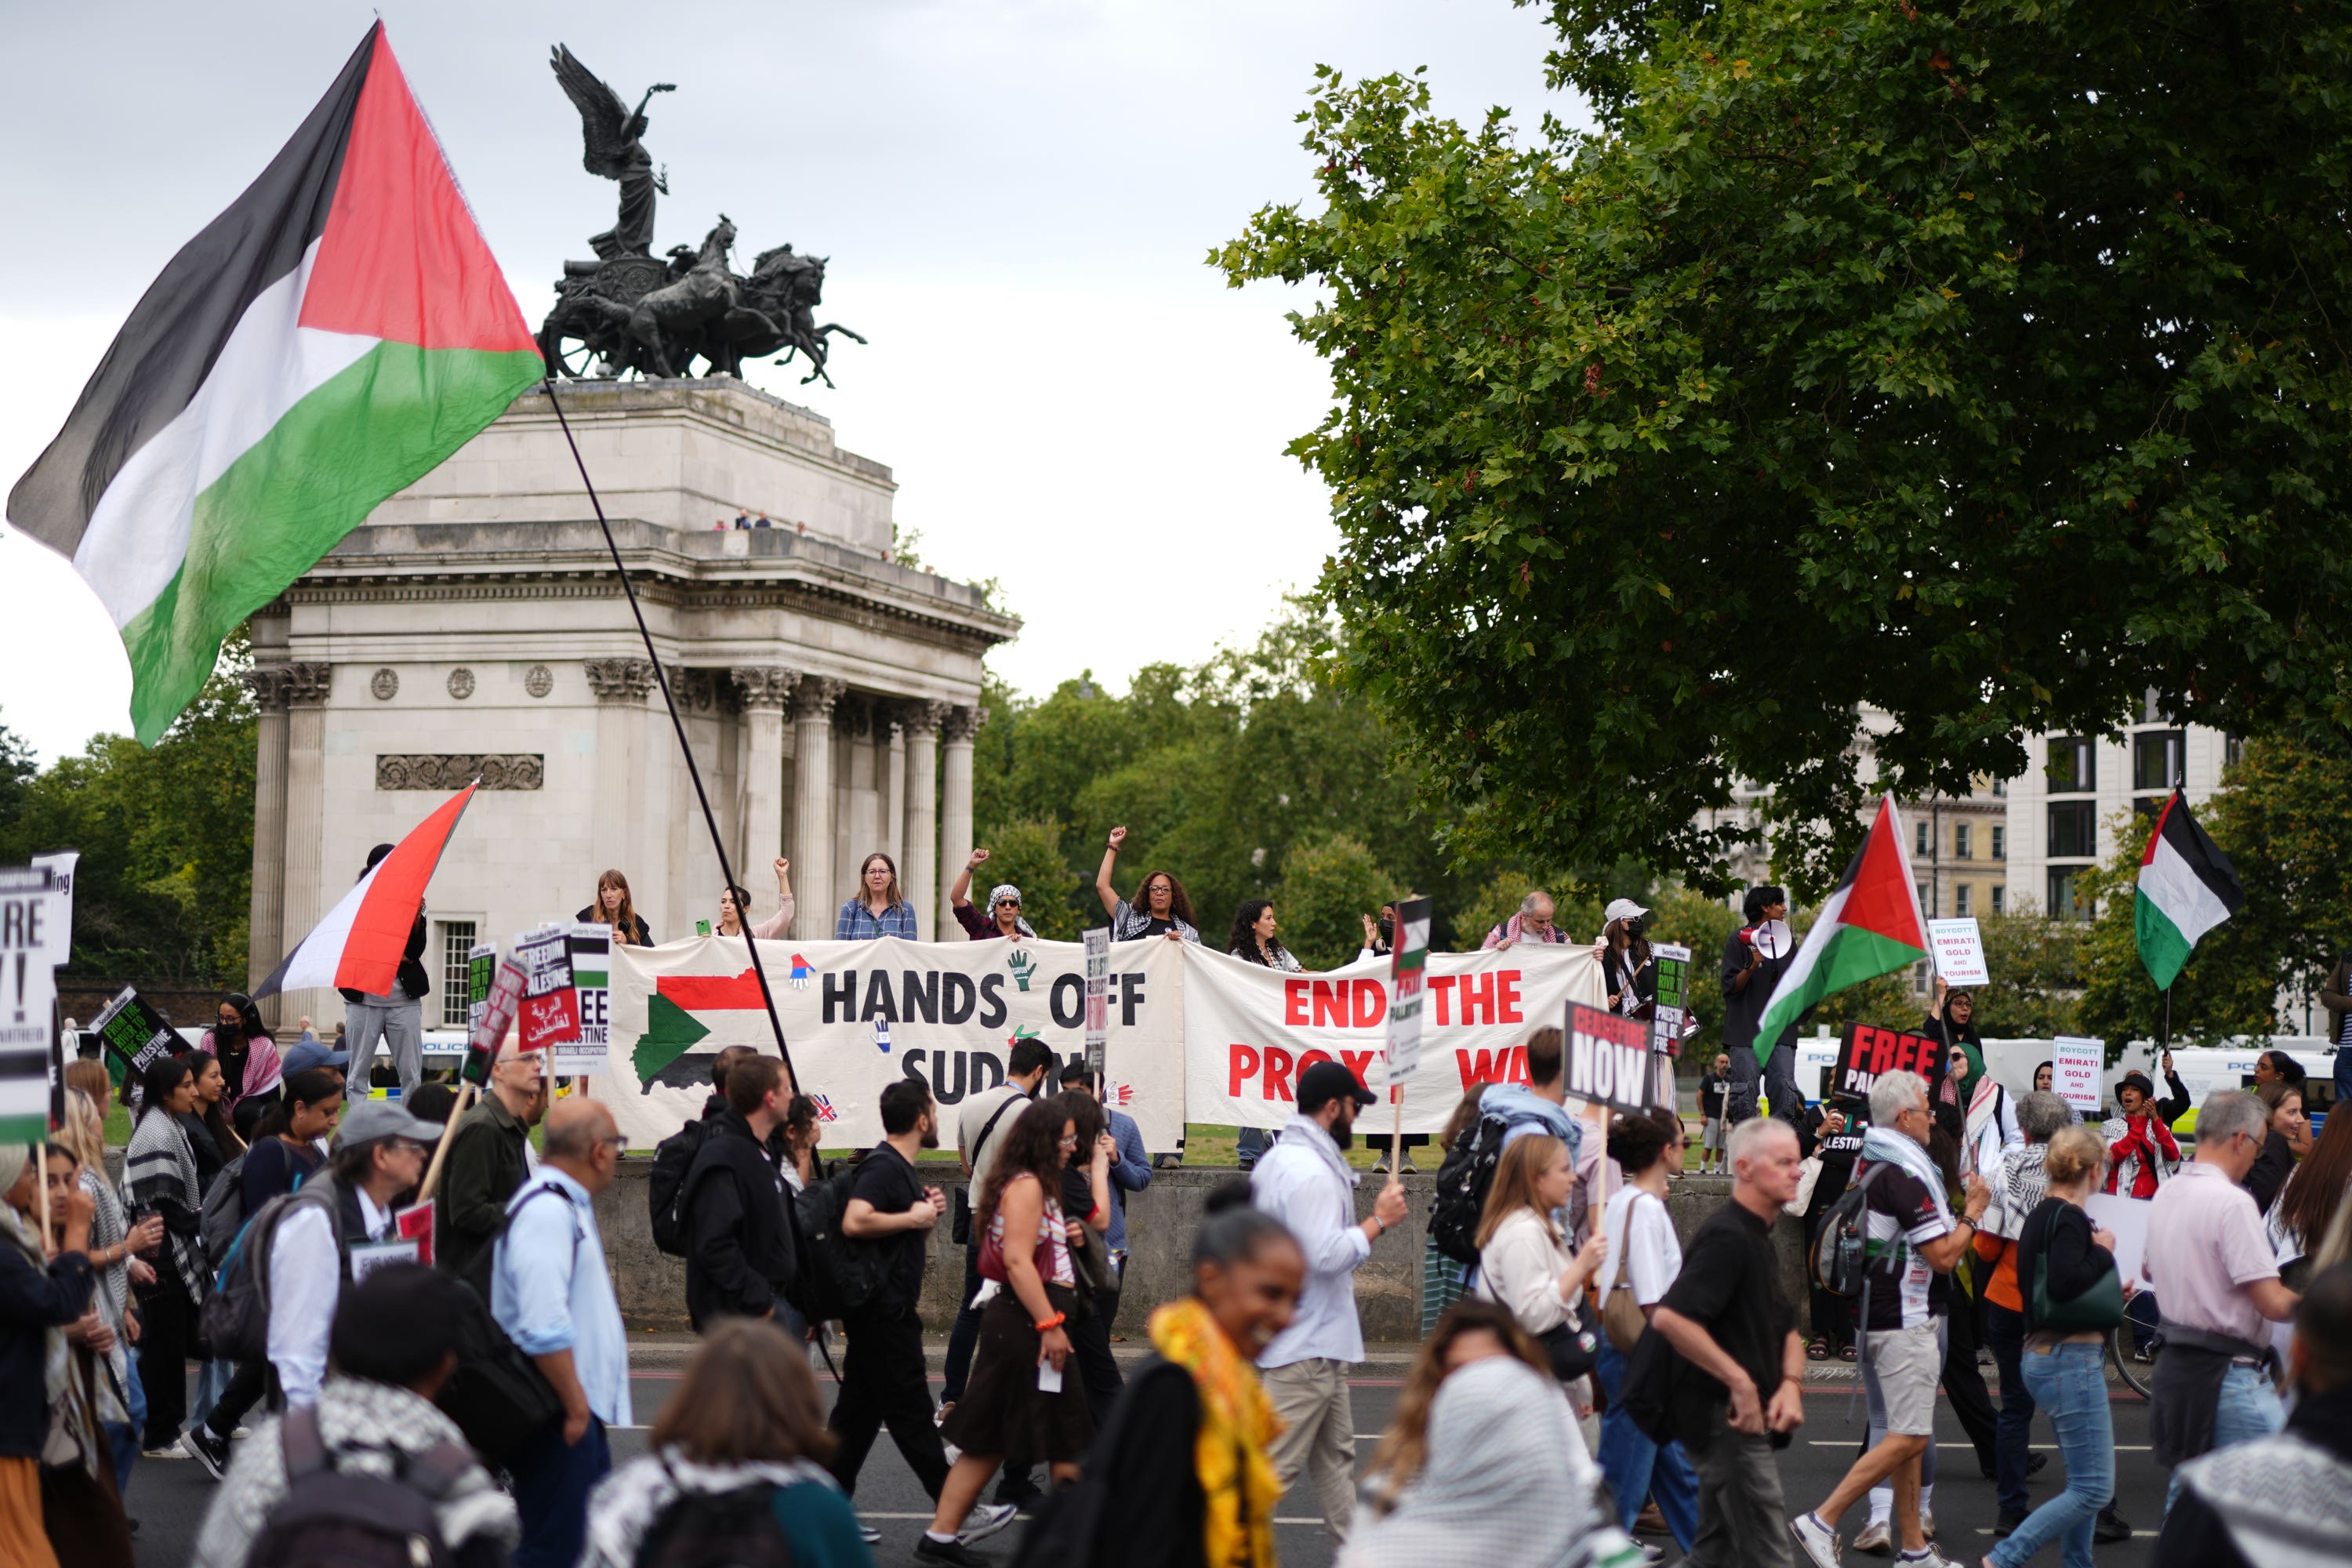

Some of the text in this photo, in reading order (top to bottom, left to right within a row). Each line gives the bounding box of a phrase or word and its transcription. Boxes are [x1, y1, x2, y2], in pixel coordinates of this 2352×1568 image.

[52, 871, 70, 895] ing
[0, 898, 45, 948] RE
[527, 966, 572, 997] ALESTINE
[822, 969, 1007, 1029] HANDS
[1284, 970, 1523, 1028] END THE
[103, 1001, 141, 1040] FROM THE
[581, 989, 608, 1025] EE
[112, 1015, 147, 1049] RIVER TO
[1573, 1006, 1648, 1052] CEASEFIRE
[1668, 1022, 1679, 1040] BE
[131, 1029, 172, 1069] PALESTINE
[421, 1043, 470, 1051] OLICE
[1849, 1023, 1939, 1087] FREE
[2058, 1057, 2099, 1067] EMIRATI
[2060, 1046, 2099, 1055] BOYCOTT
[1570, 1030, 1647, 1108] NOW
[2064, 1069, 2092, 1079] GOLD
[2057, 1092, 2096, 1101] TOURISM
